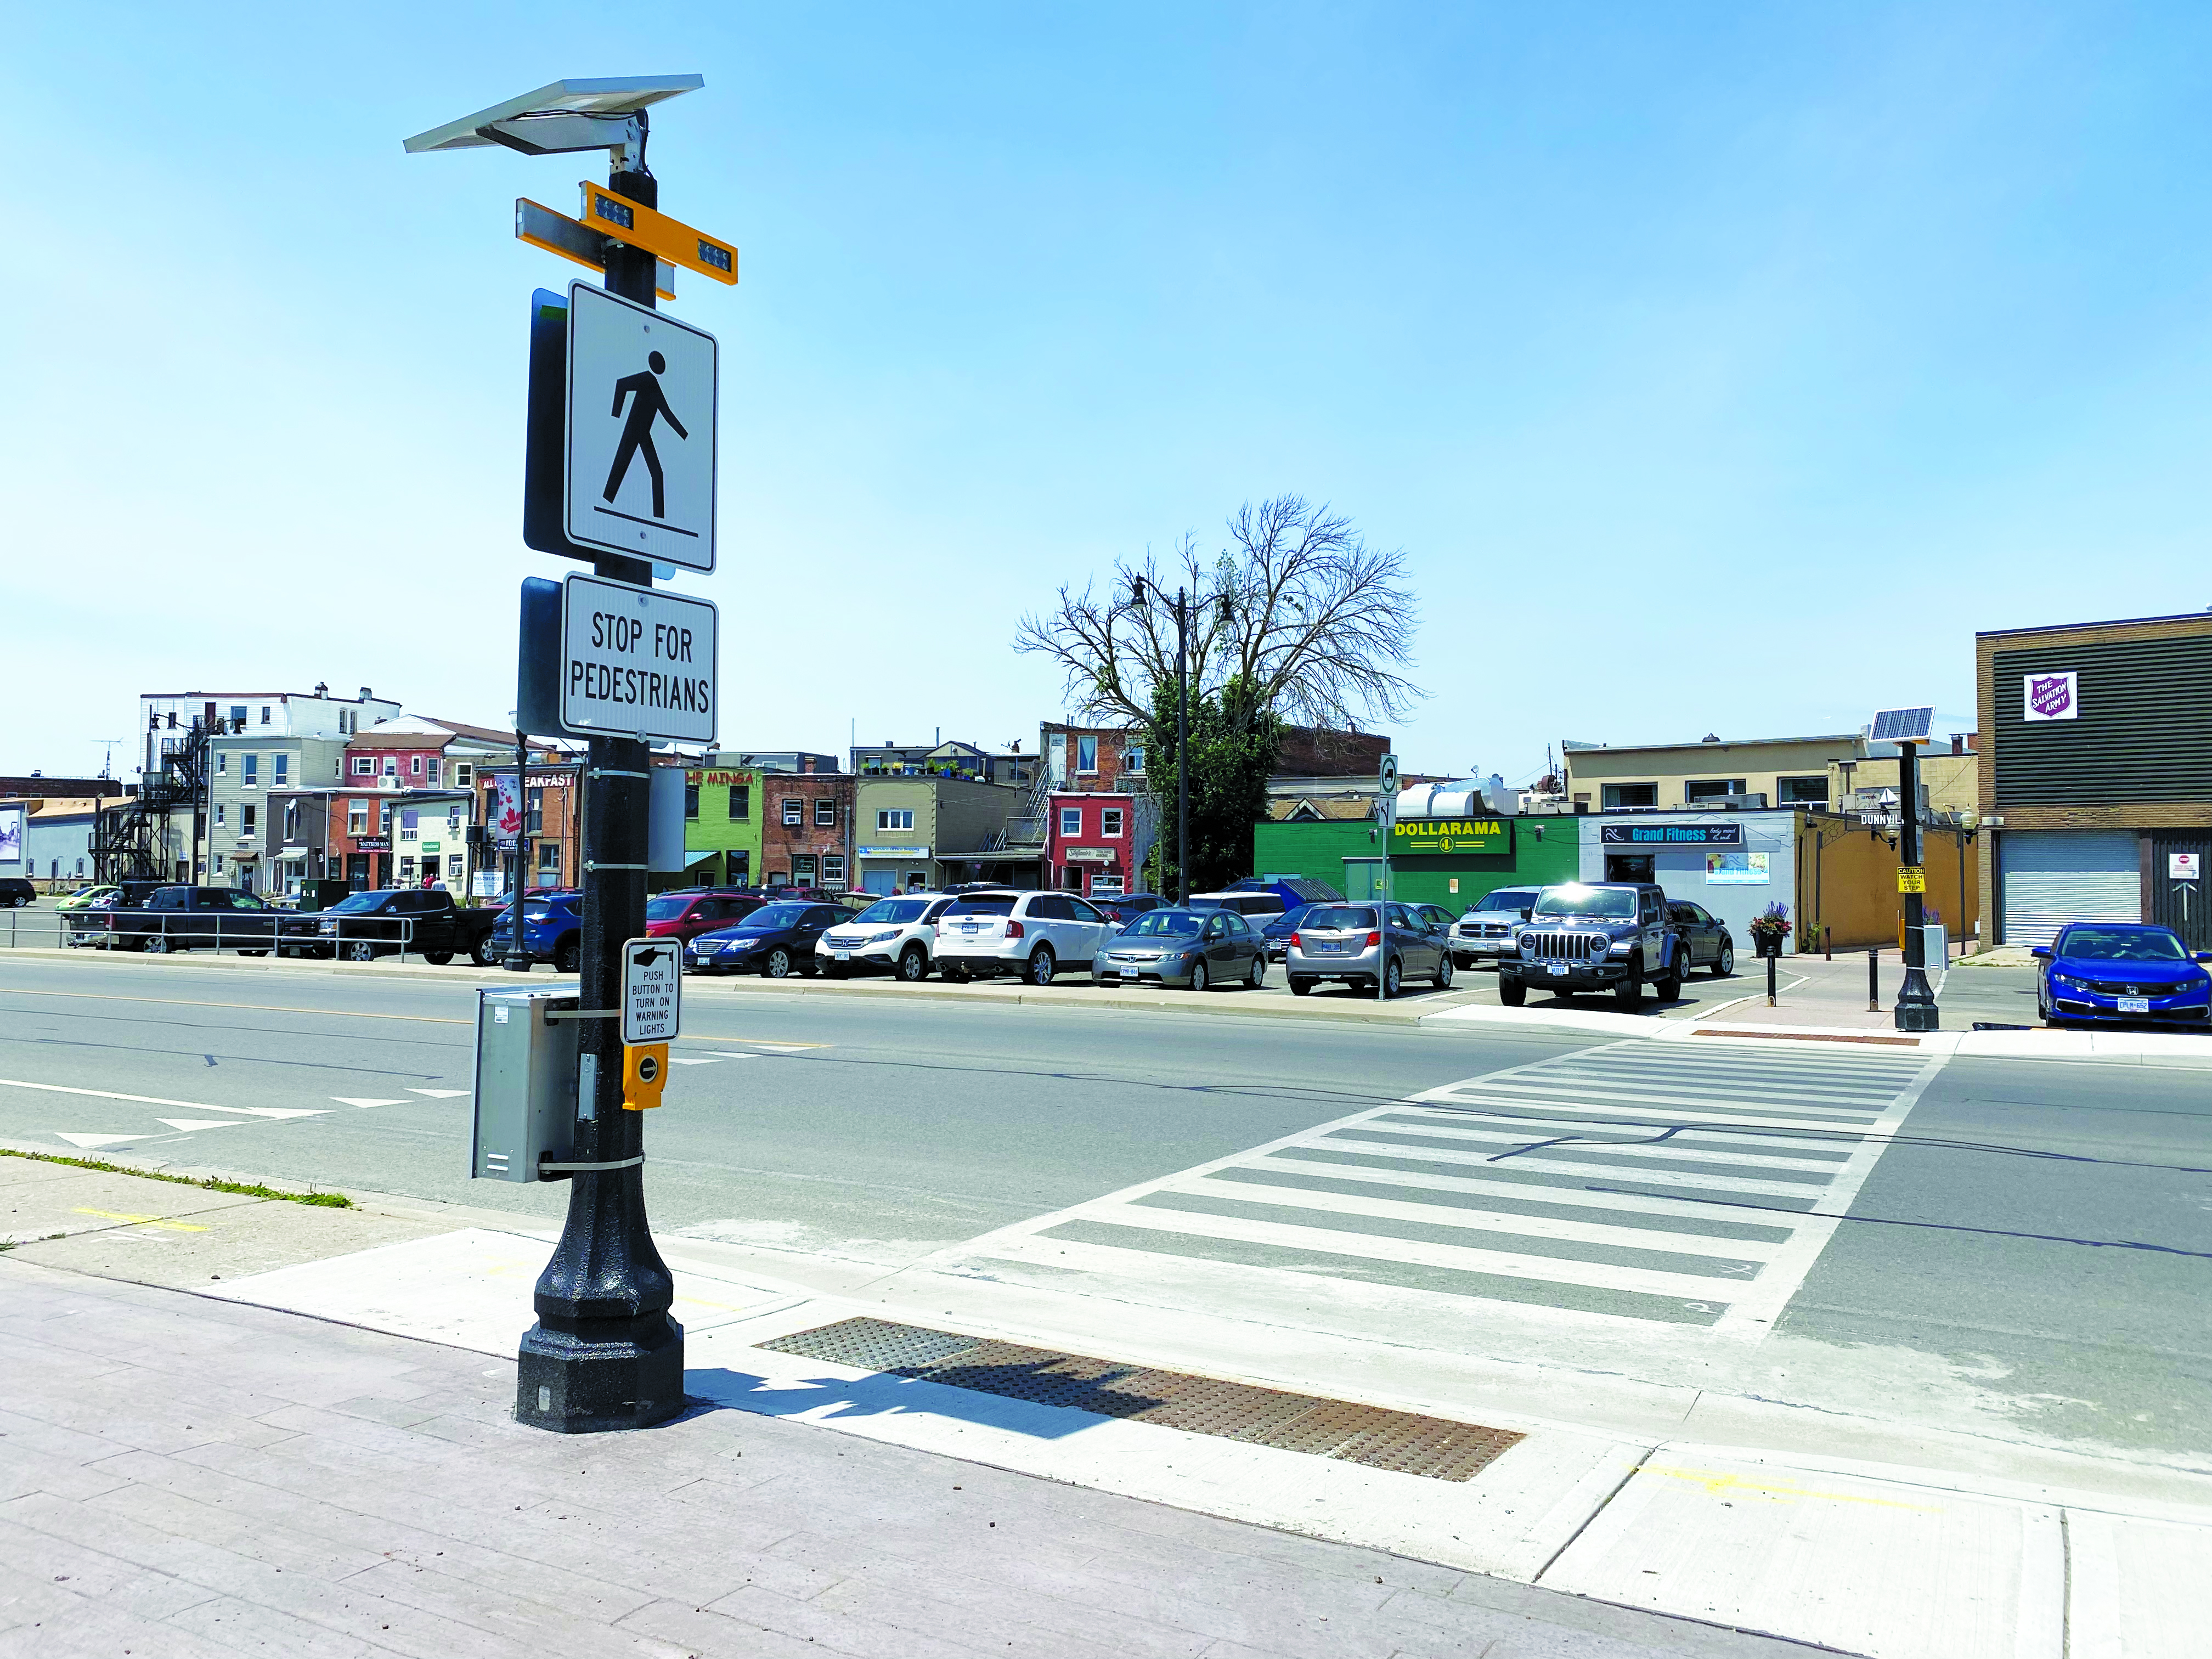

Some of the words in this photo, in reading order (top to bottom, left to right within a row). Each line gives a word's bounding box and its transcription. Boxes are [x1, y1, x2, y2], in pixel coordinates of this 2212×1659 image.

[591, 611, 642, 653] STOP
[655, 623, 692, 663] FOR
[571, 660, 709, 713] PEDESTRIANS
[2036, 680, 2053, 694] THE
[2032, 681, 2067, 708] SALVATION
[2045, 693, 2067, 713] ARMY
[483, 780, 494, 789] ALL
[524, 774, 572, 787] EAKFAST
[707, 772, 754, 787] MINGA
[1395, 821, 1501, 836] DOLLARAMA
[1633, 828, 1663, 841] Grand
[1667, 827, 1706, 841] Fitness
[1709, 827, 1722, 836] body
[644, 970, 663, 981] PUSH
[633, 984, 660, 995] BUTTON
[664, 983, 674, 993] TO
[635, 998, 654, 1008] TURN
[659, 997, 670, 1007] ON
[636, 1010, 668, 1022] WARNING
[639, 1023, 664, 1035] LIGHTS
